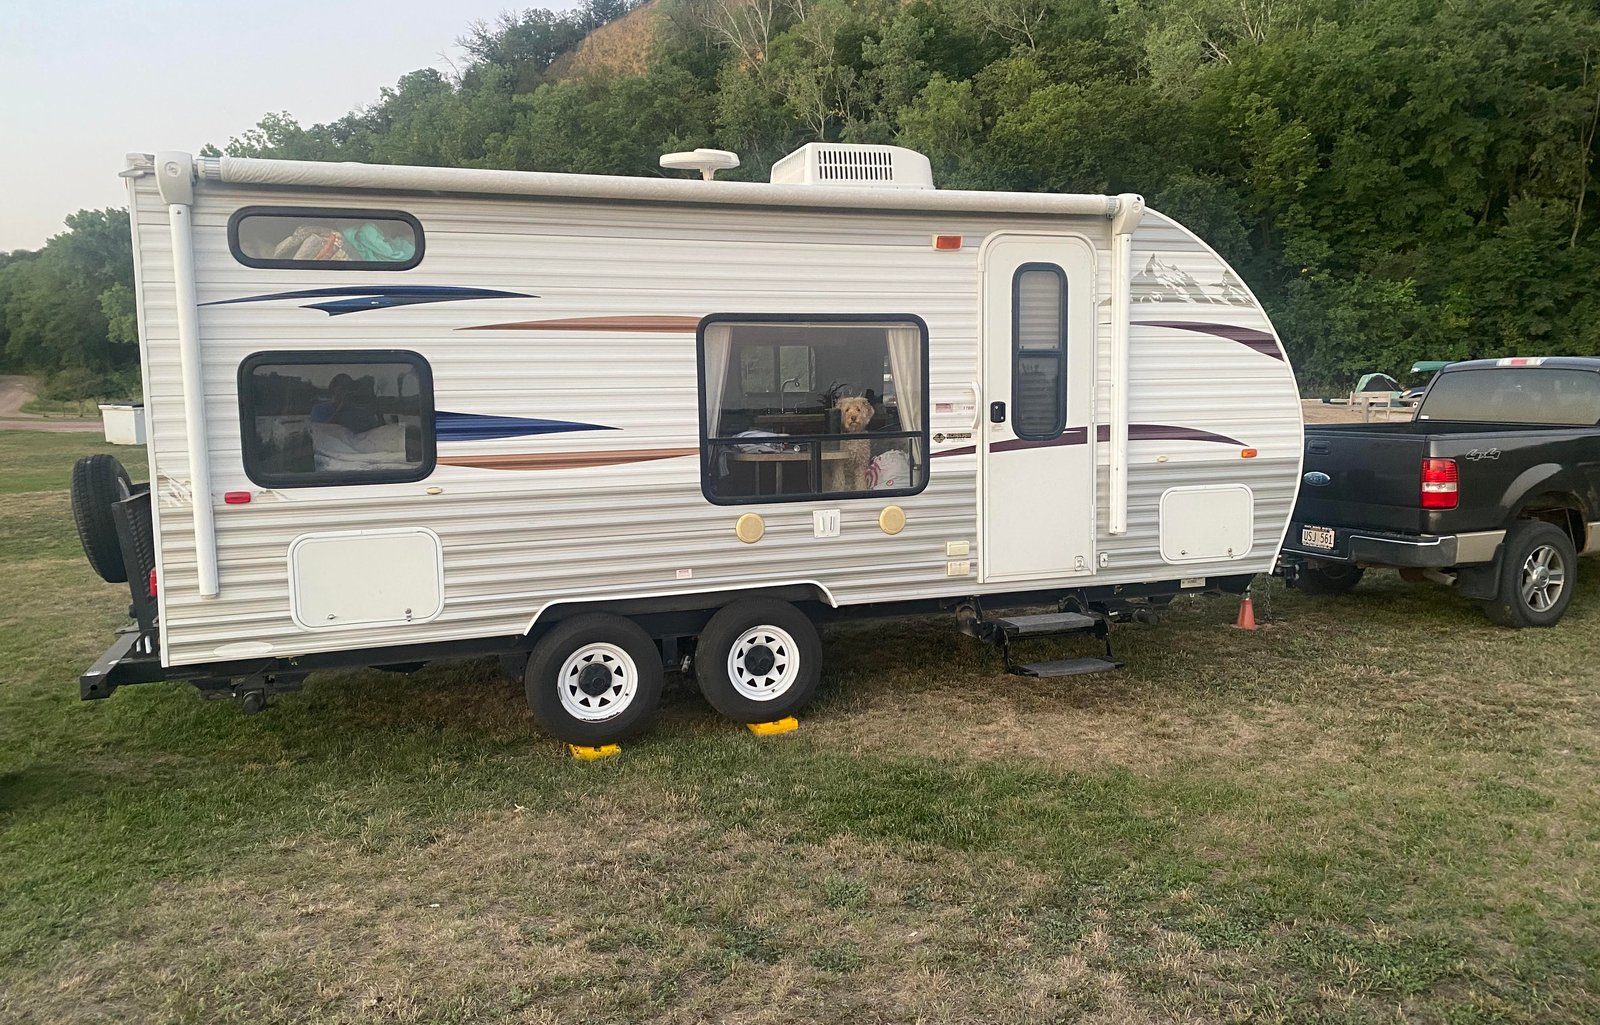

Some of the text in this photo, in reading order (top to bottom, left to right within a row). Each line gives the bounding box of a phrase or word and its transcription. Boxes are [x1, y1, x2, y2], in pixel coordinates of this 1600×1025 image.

[1465, 448, 1501, 461] 4x4
[1304, 531, 1332, 544] USJ 561
